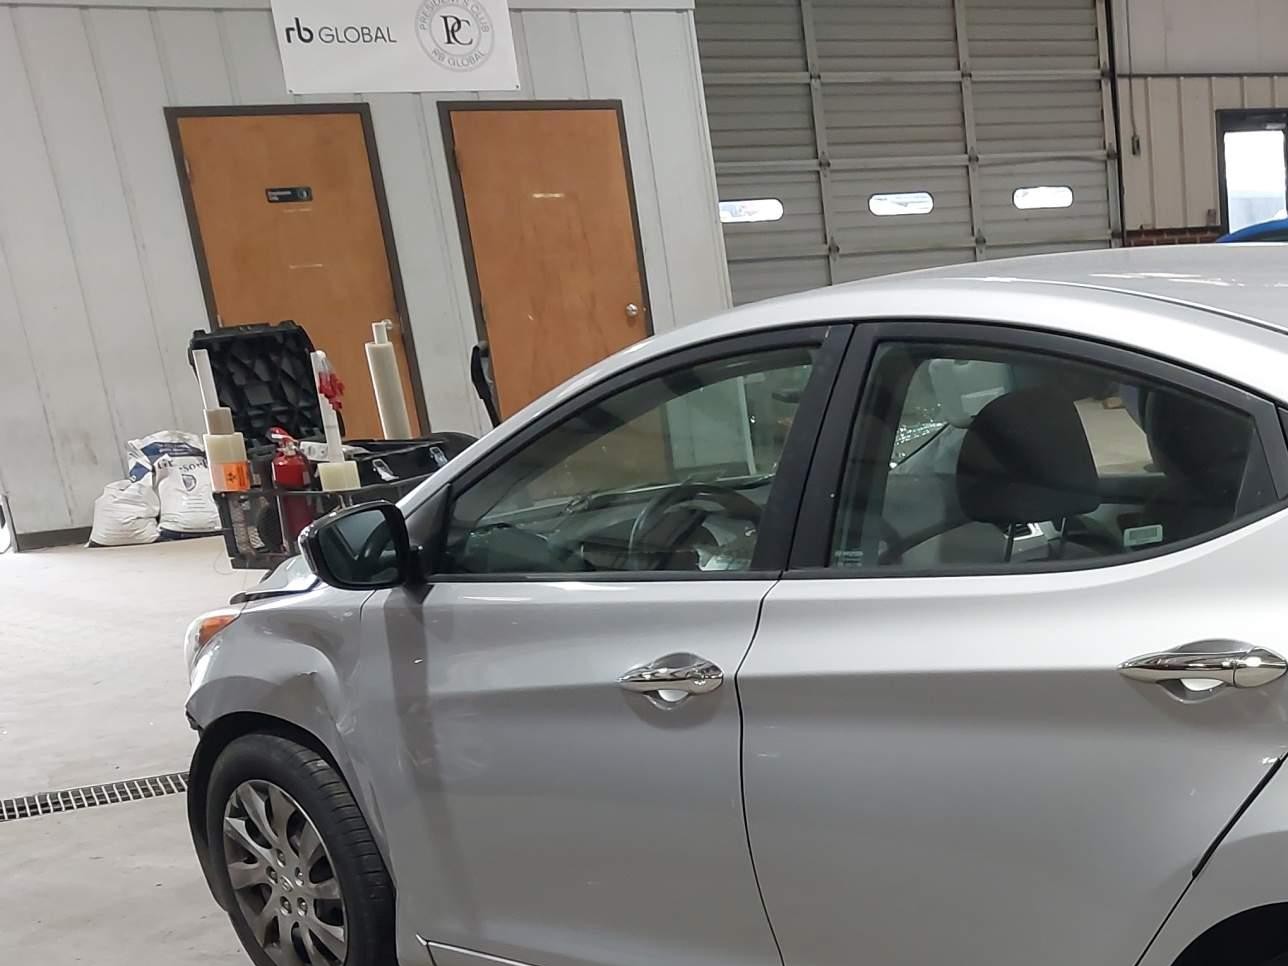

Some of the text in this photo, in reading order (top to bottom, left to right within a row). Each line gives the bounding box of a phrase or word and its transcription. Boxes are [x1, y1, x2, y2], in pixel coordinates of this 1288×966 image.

[285, 17, 397, 43] rb GLOBAL
[447, 50, 486, 67] GLOBAL
